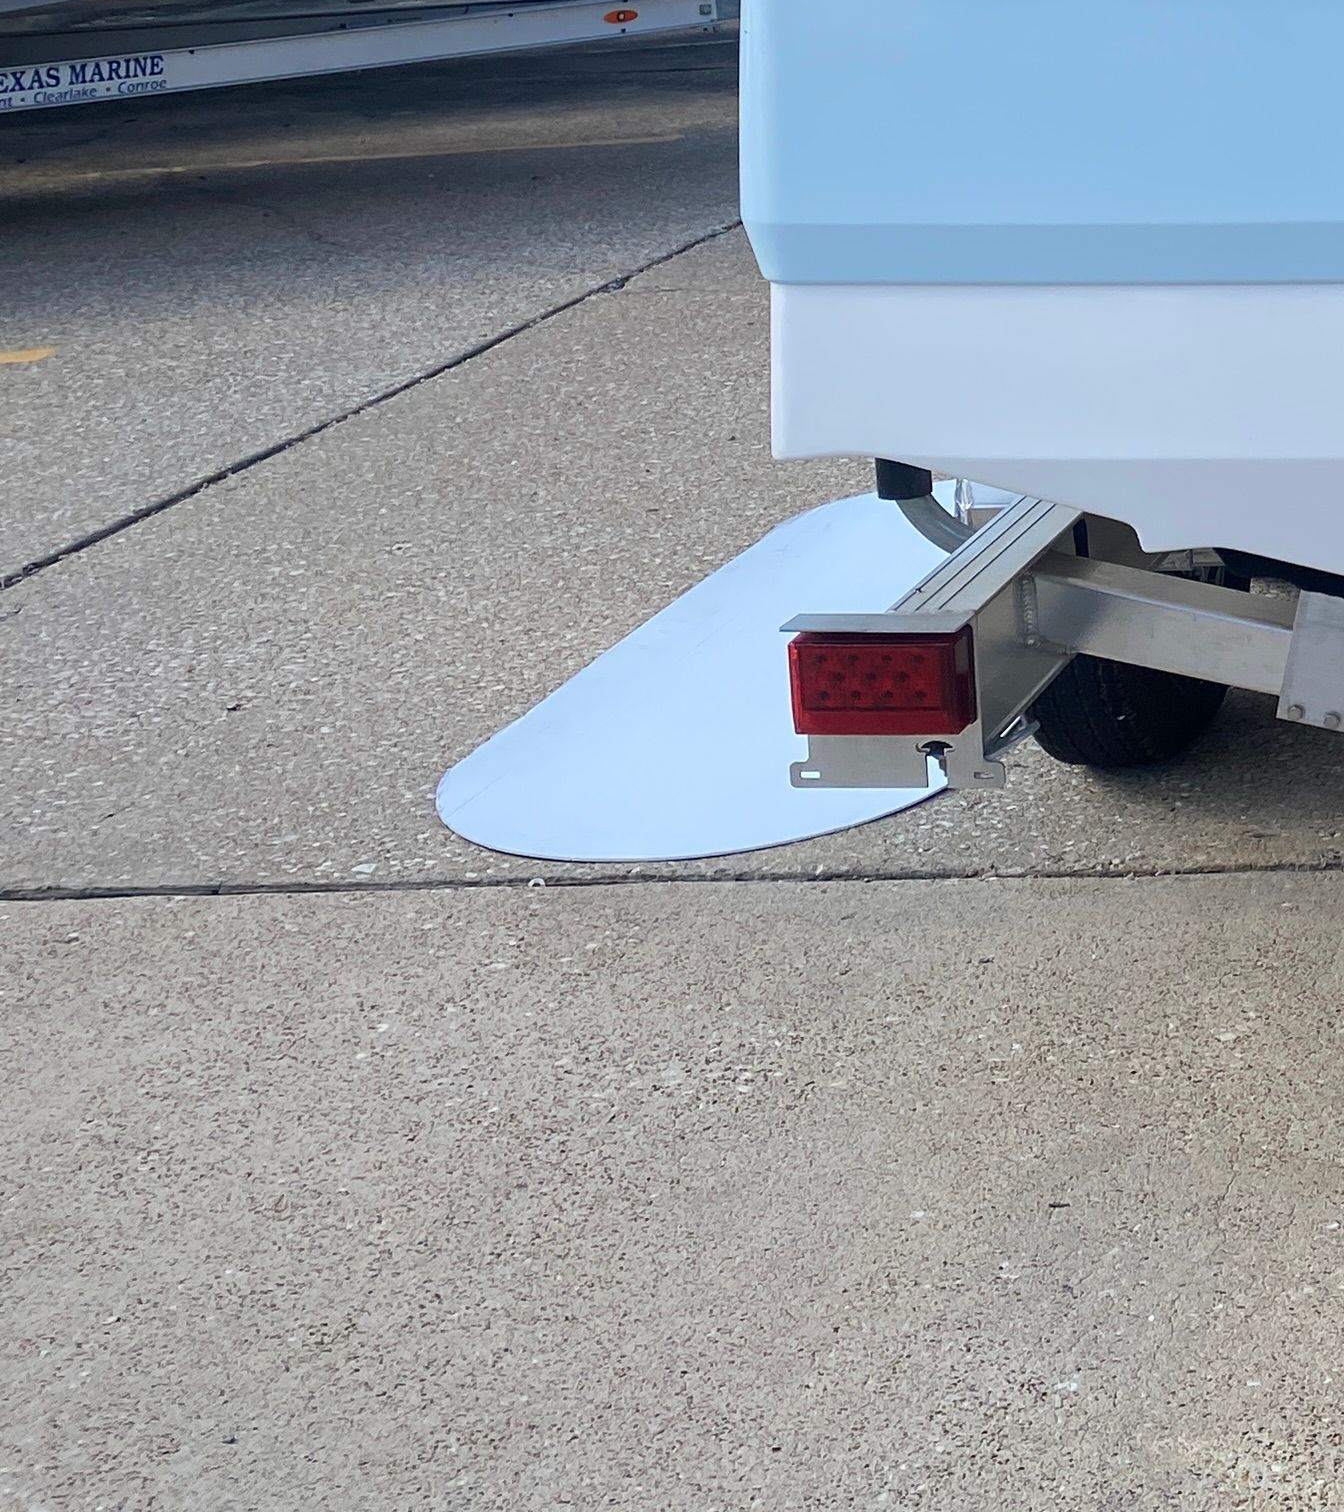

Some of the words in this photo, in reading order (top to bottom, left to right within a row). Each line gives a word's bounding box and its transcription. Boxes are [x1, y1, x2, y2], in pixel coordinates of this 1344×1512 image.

[0, 67, 60, 94] EXAS
[68, 55, 165, 86] MARINE
[34, 87, 98, 105] Clearlake
[118, 78, 168, 94] Conroe
